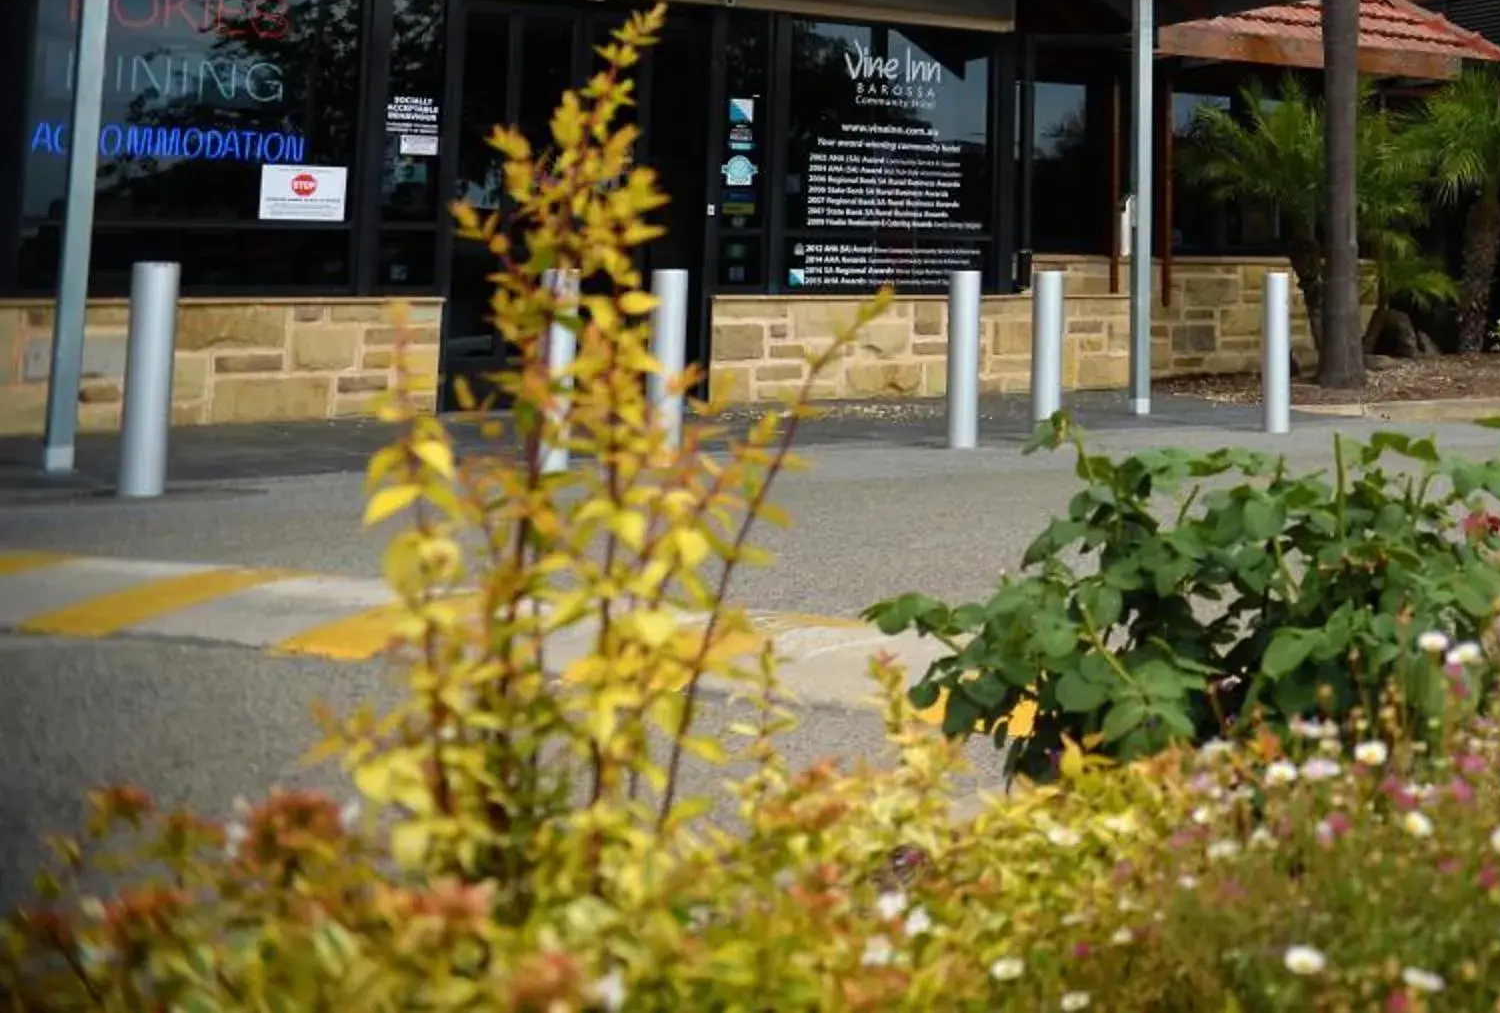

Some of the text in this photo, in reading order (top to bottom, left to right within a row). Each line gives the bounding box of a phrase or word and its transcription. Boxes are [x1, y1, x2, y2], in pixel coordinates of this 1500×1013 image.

[67, 49, 283, 103] INING
[844, 39, 942, 83] Vine Inn
[855, 95, 909, 109] Community
[856, 82, 936, 98] BAROSSA
[31, 123, 306, 163] ACOMMODATION
